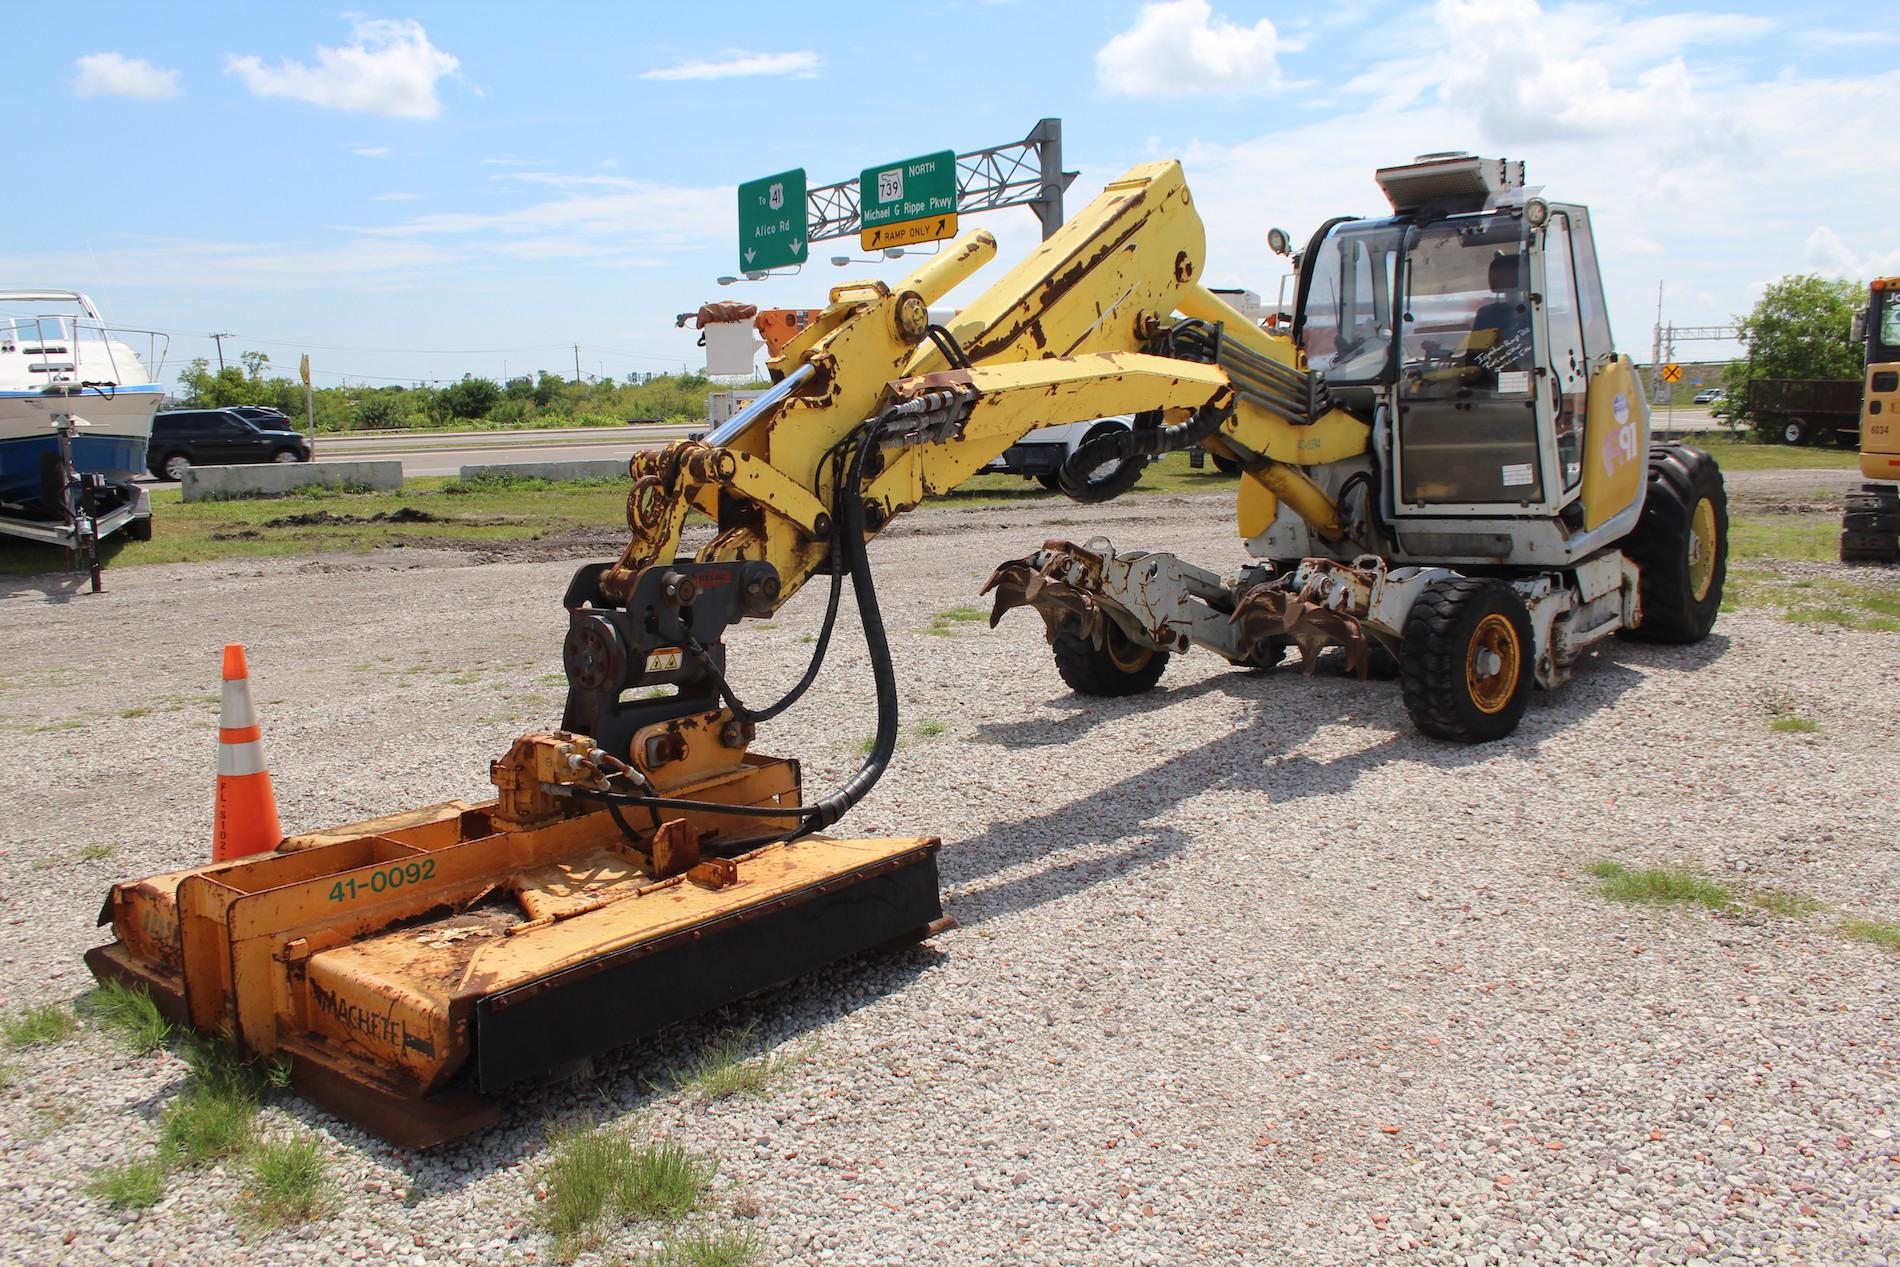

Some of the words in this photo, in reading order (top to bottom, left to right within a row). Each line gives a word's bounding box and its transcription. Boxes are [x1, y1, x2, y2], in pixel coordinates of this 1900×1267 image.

[908, 161, 936, 178] NORTH
[758, 196, 767, 206] To
[771, 189, 781, 204] 41
[879, 181, 899, 198] 739
[864, 206, 891, 222] Michael
[894, 204, 900, 216] G
[904, 201, 925, 215] Rippe
[929, 196, 953, 210] Pkwy
[754, 224, 776, 238] Alico
[779, 220, 790, 233] Rd
[884, 229, 906, 241] RAMP
[909, 225, 931, 238] ONLY
[328, 858, 436, 903] 41-0092
[316, 987, 401, 1048] MACHETE
